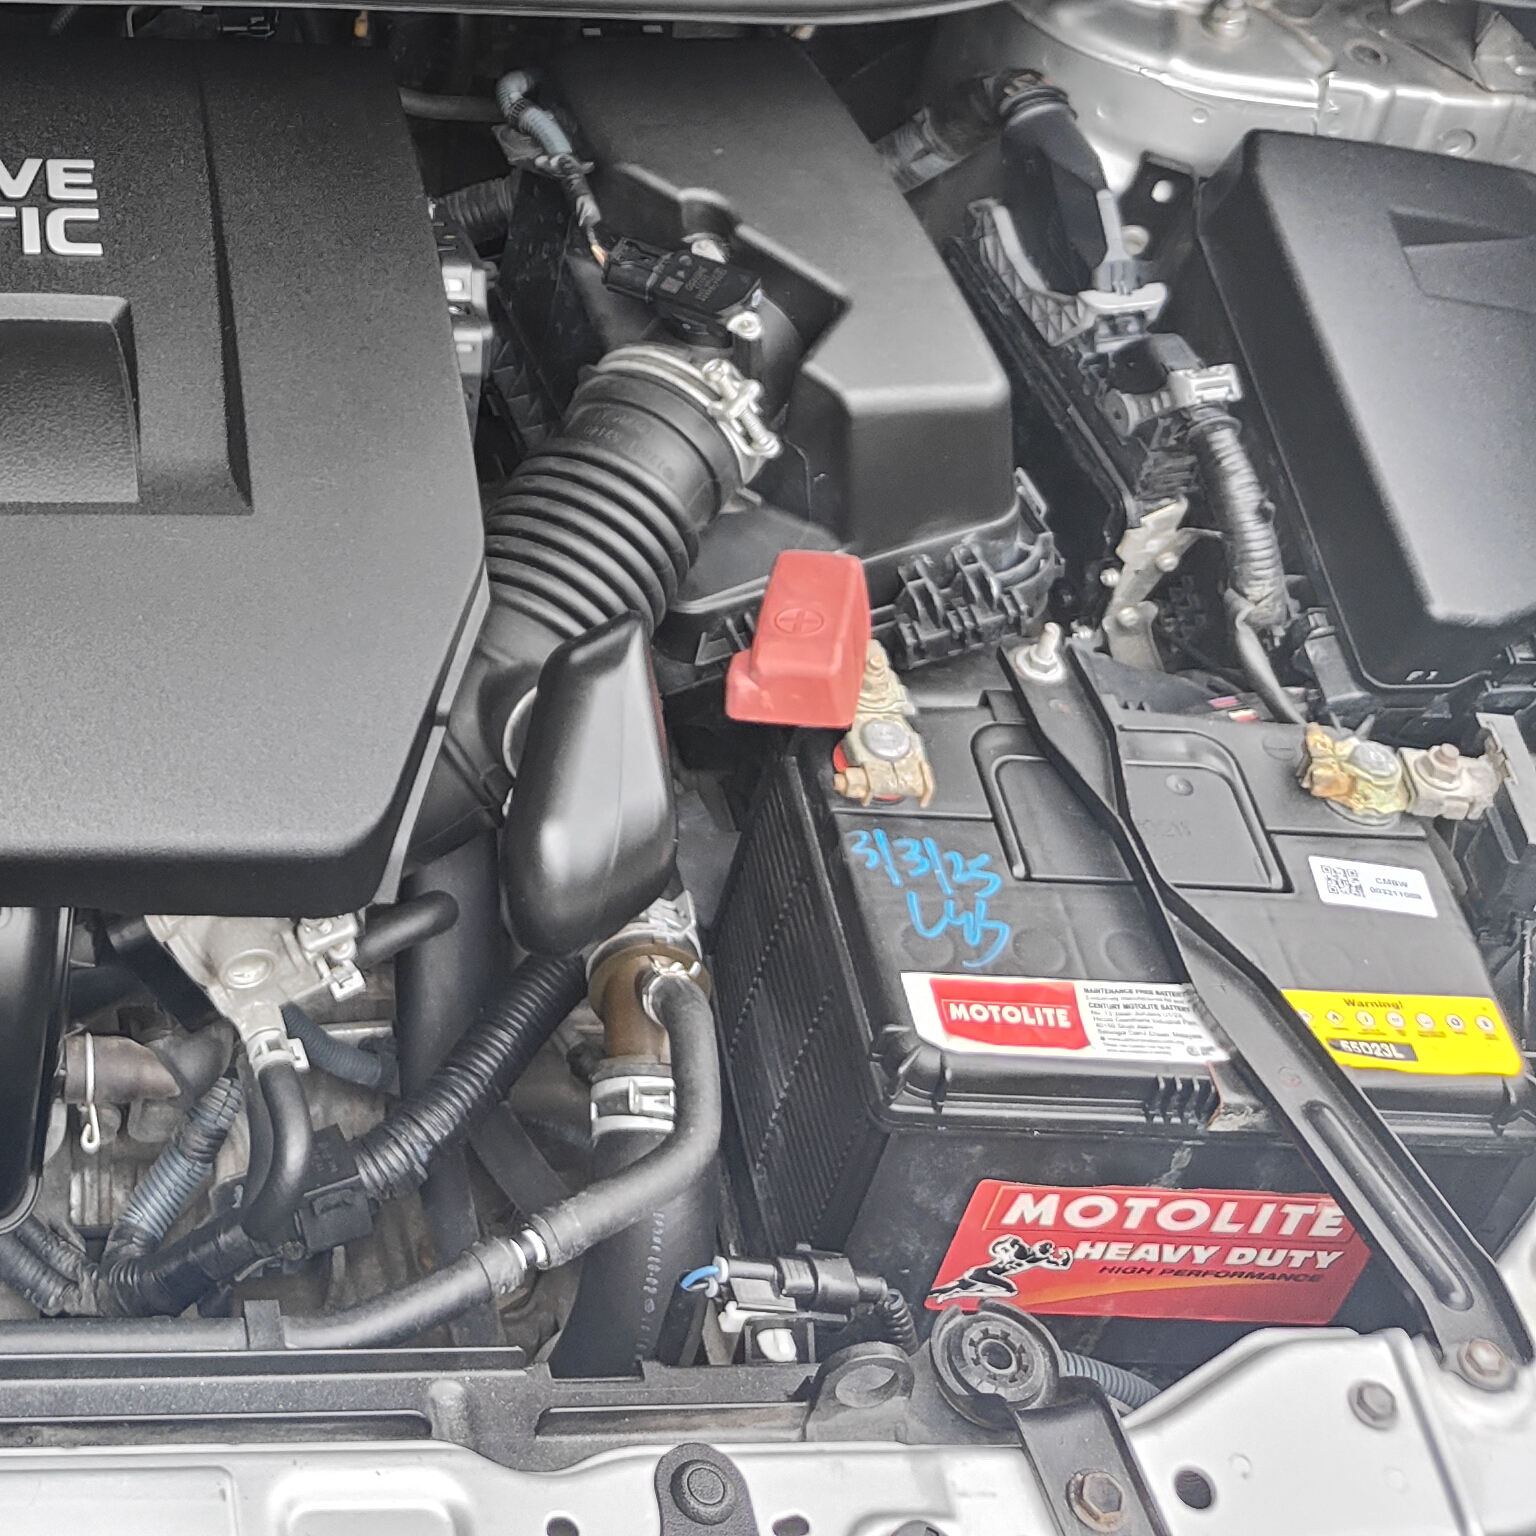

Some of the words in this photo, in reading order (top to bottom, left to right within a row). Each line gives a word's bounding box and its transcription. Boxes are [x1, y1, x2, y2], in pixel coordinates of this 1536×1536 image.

[845, 828, 1003, 900] 3/3/25
[949, 1002, 1072, 1029] MOTOLITE
[1122, 1003, 1160, 1011] MOTOLITE
[1343, 997, 1404, 1010] Warning!
[1000, 1191, 1346, 1238] MOTOLITE
[1073, 1239, 1220, 1266] HEAVY
[1225, 1247, 1345, 1270] DUTY
[1098, 1264, 1155, 1276] HIGH
[1160, 1267, 1325, 1283] PERFORMANCE
